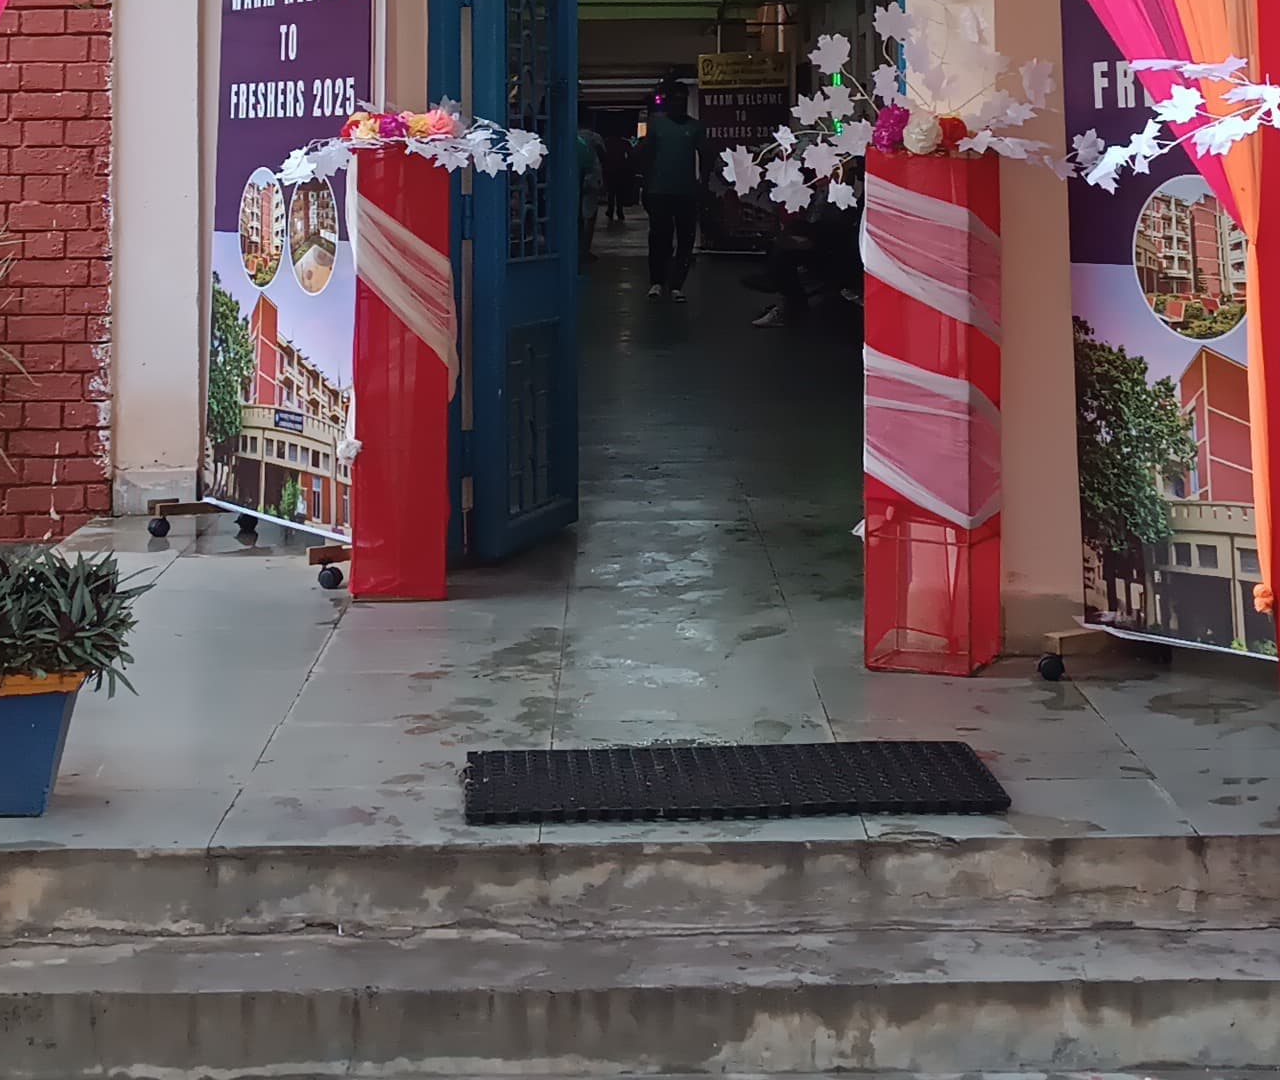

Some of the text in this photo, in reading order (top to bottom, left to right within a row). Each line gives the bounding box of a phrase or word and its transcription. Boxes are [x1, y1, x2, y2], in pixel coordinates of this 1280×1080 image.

[279, 23, 297, 61] TO
[230, 76, 355, 119] FRESHERS 2025
[704, 92, 784, 106] WARM WELCOME
[735, 110, 747, 121] TO
